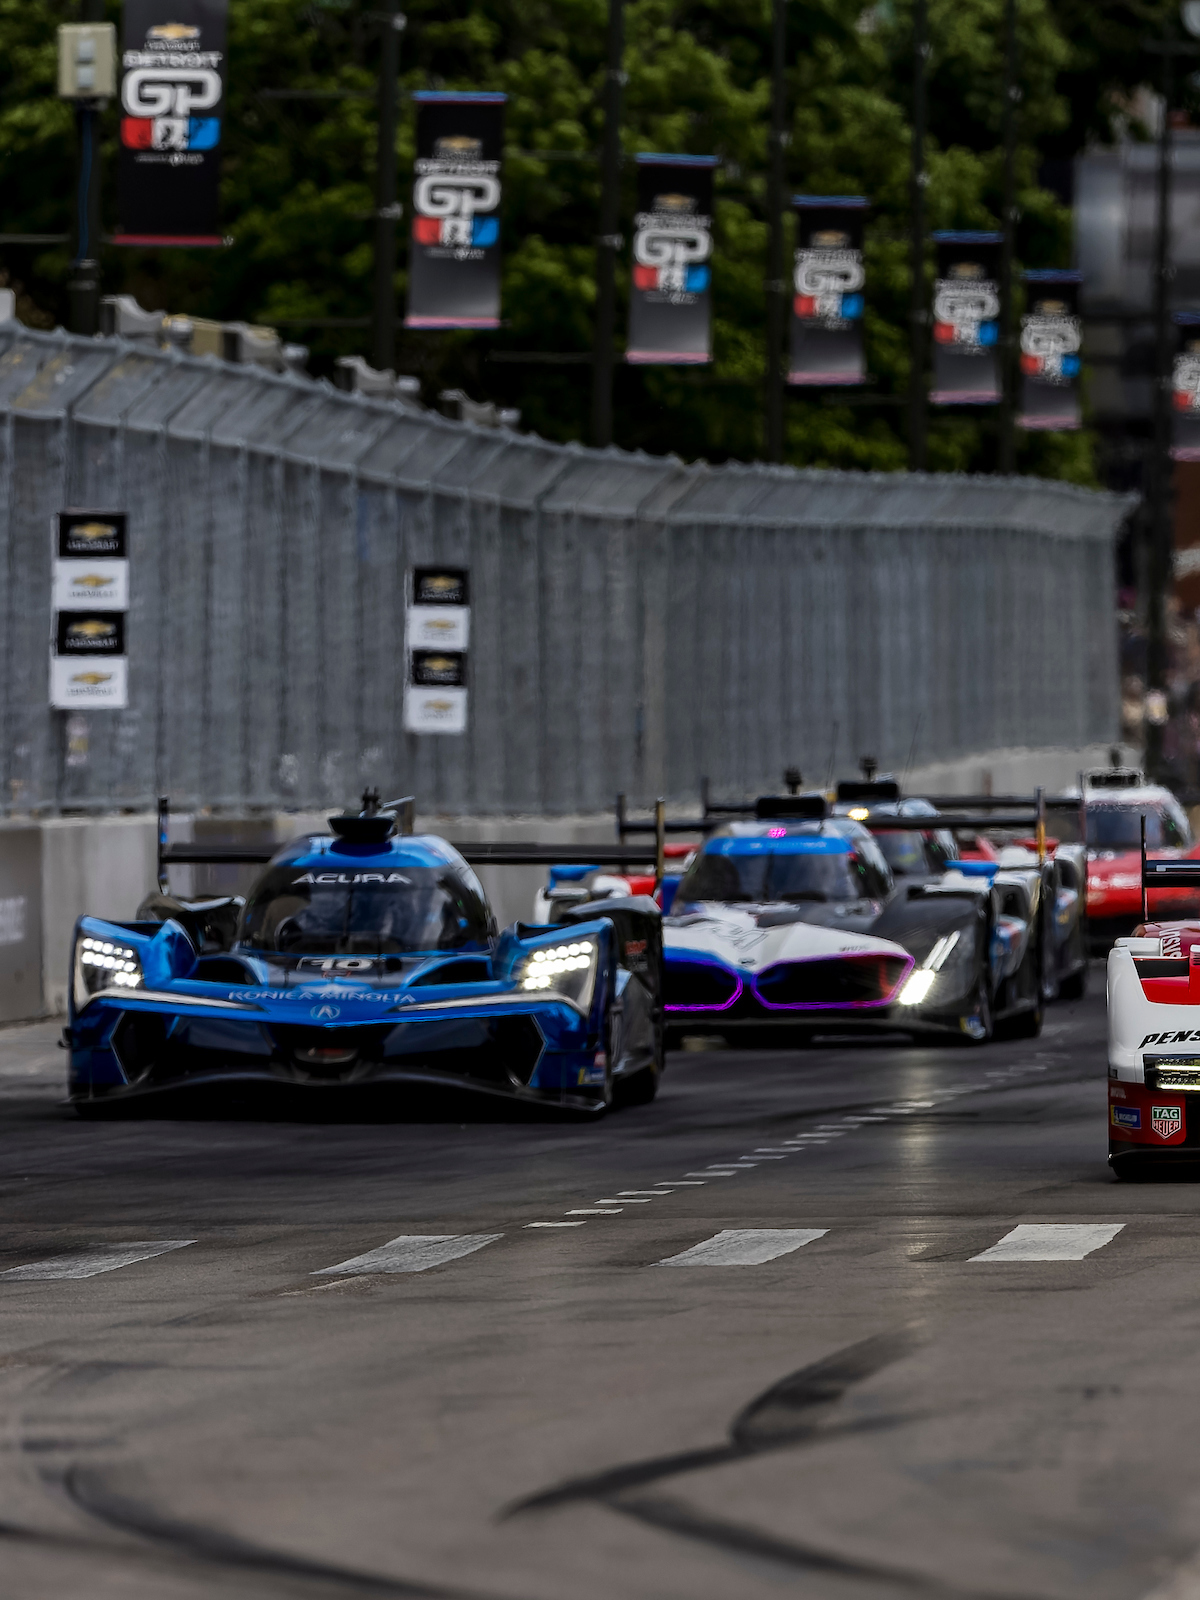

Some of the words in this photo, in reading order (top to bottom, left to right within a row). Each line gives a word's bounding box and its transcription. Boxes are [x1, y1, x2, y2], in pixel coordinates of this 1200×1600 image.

[122, 69, 221, 117] GP
[413, 175, 501, 217] GP
[291, 872, 412, 885] ACURA
[228, 990, 314, 1000] KONICA
[319, 990, 416, 1003] MINOLTA
[1154, 1108, 1179, 1119] TAG
[1152, 1120, 1180, 1136] HEUER
